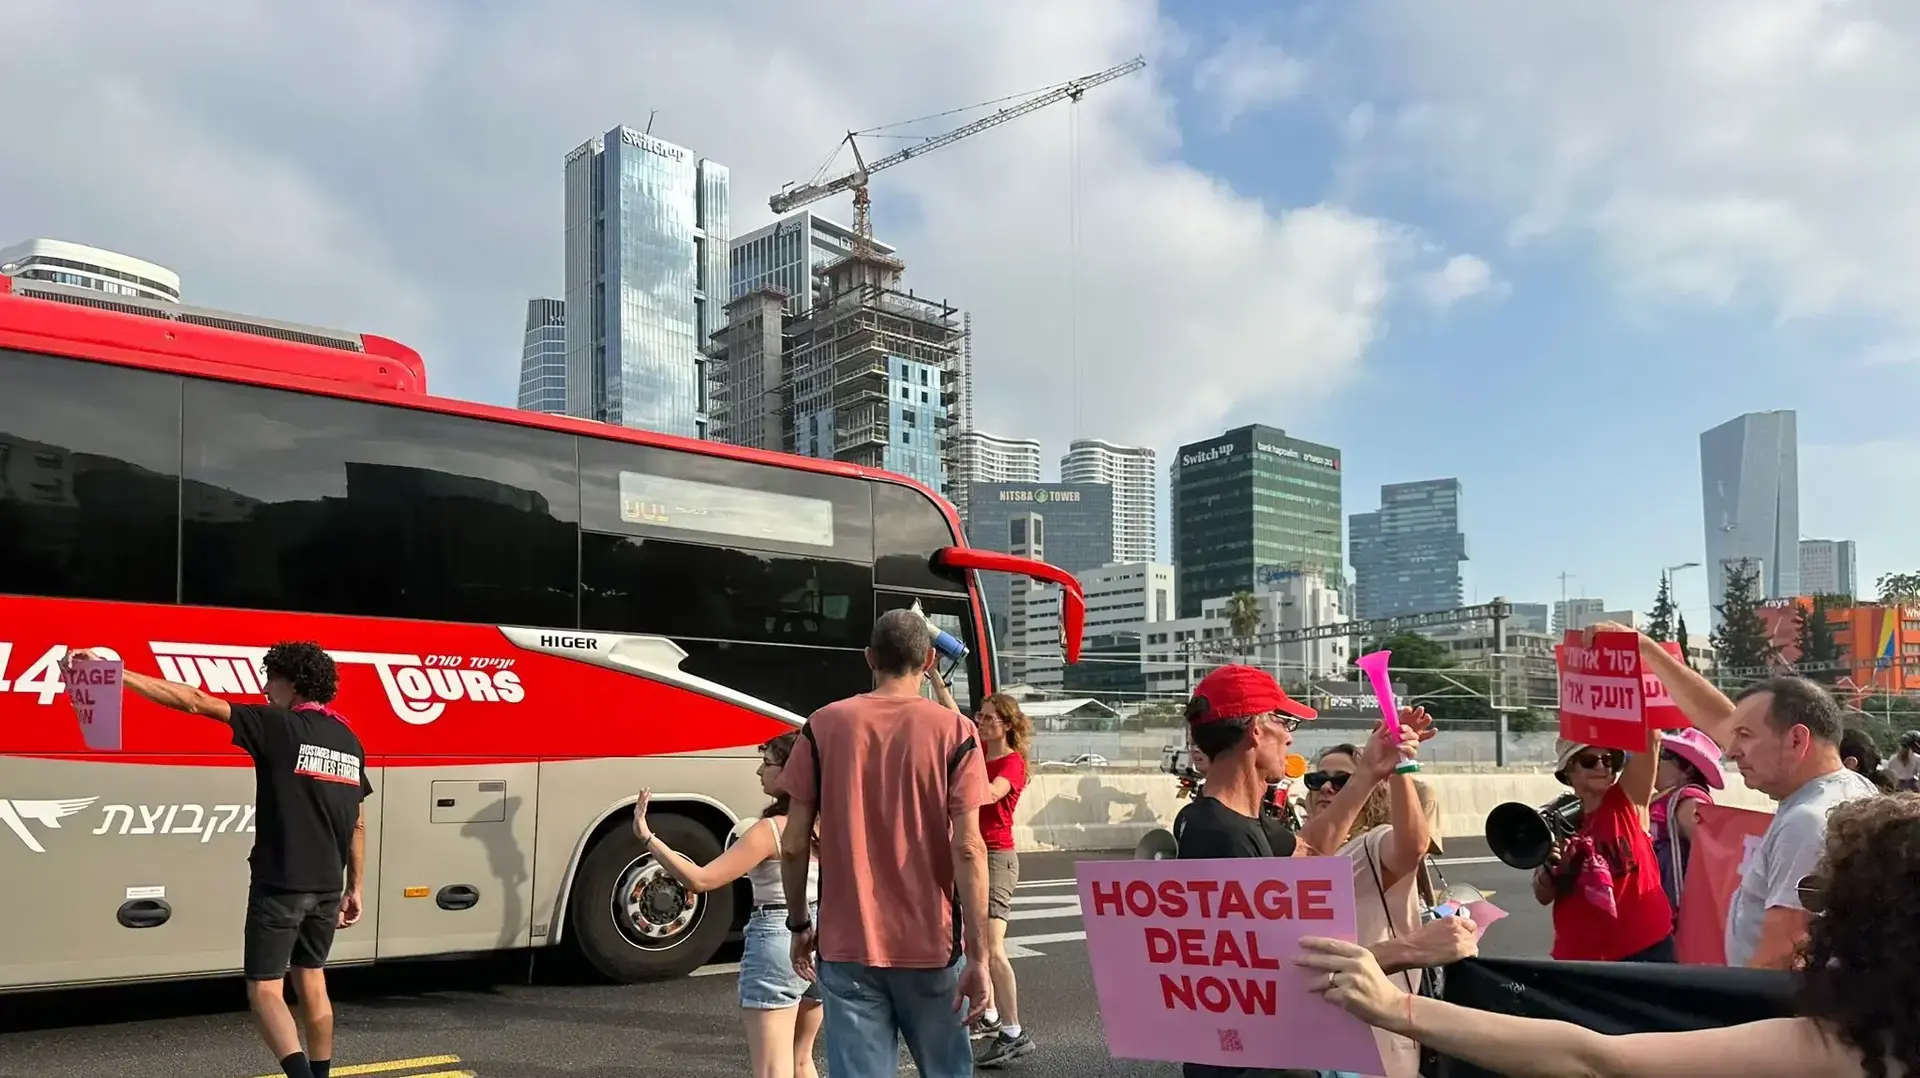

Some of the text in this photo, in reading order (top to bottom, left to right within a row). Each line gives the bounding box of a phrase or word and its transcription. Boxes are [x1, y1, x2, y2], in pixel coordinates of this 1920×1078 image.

[999, 490, 1080, 502] NITSBA TOWER
[540, 635, 598, 650] HIGER
[424, 654, 463, 667] טורס
[1604, 647, 1637, 675] קול
[67, 669, 116, 685] TAGE
[345, 650, 525, 725] TOURS
[1590, 685, 1634, 710] זועק
[296, 755, 360, 781] FAMILIES FORUM
[1092, 879, 1334, 920] HOSTAGE
[1144, 927, 1280, 970] DEAL
[1160, 974, 1277, 1016] NOW
